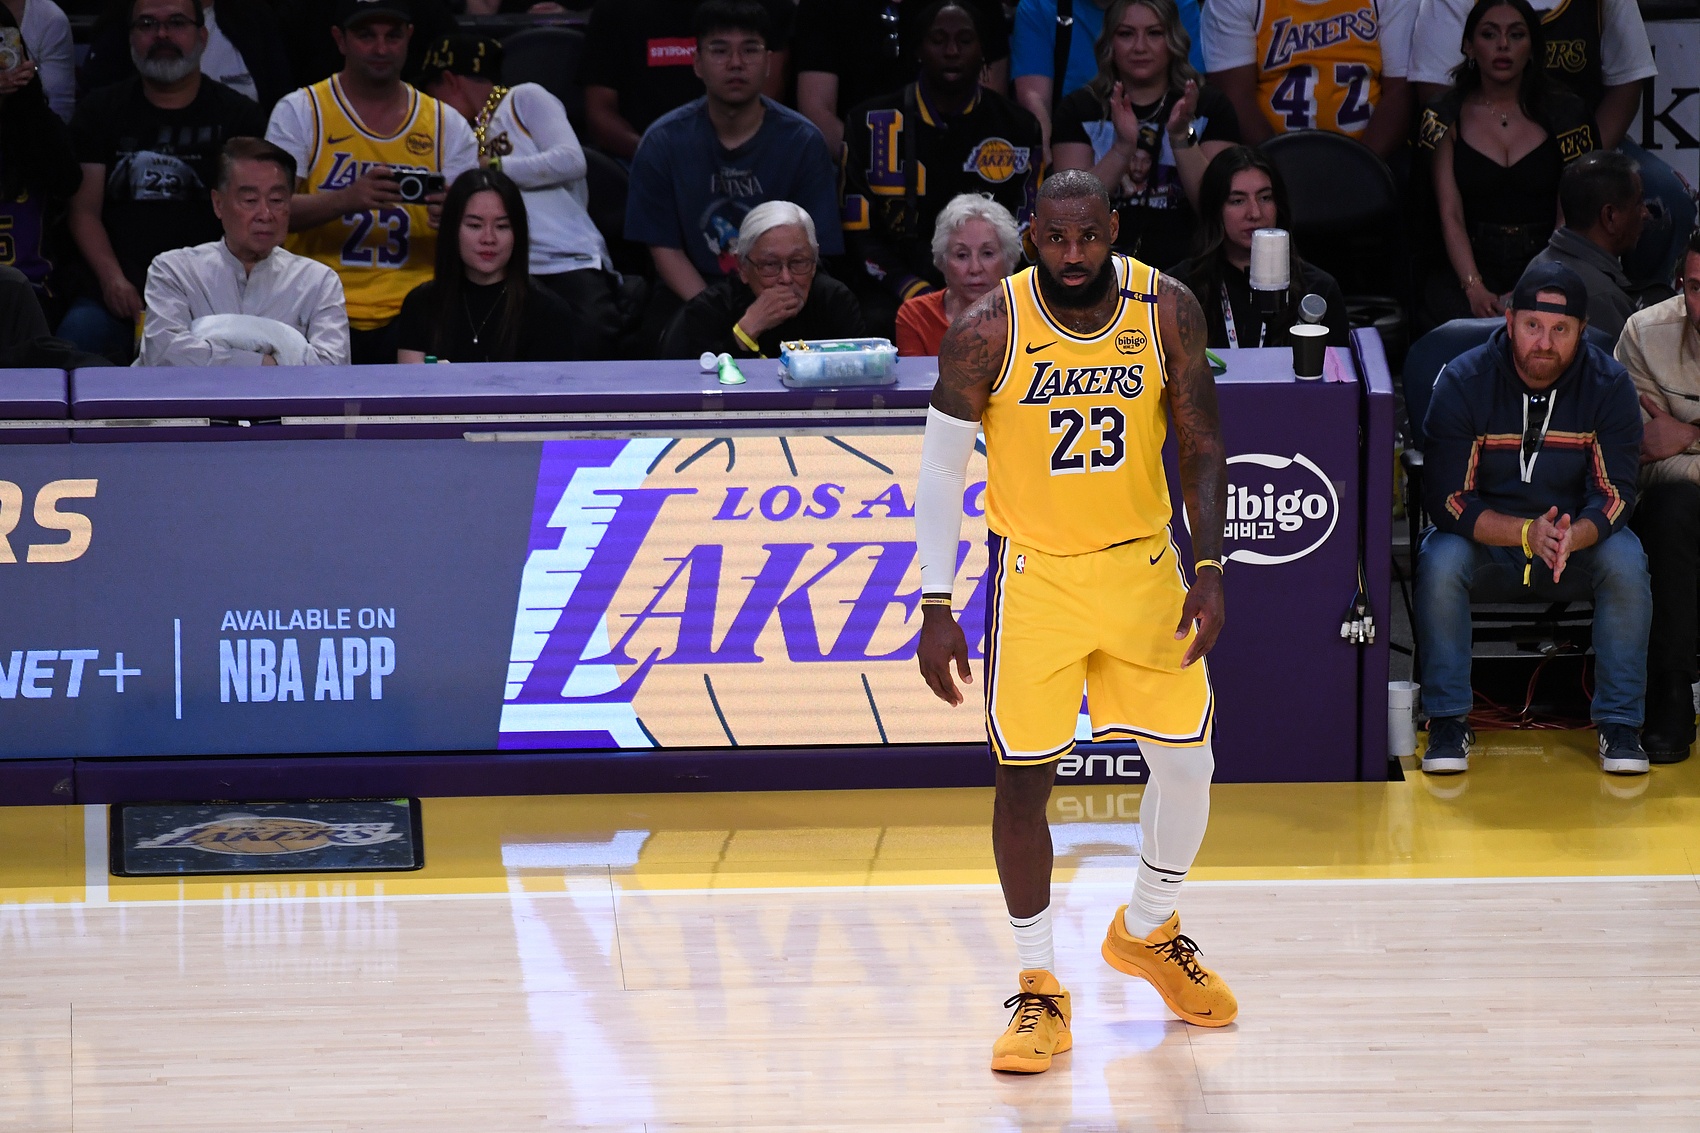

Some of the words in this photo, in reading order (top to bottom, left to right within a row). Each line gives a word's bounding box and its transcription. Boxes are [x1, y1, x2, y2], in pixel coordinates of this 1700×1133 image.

[1262, 7, 1379, 71] LAKERS
[1270, 63, 1376, 132] 42
[145, 169, 182, 197] 23
[341, 203, 411, 268] 23
[1118, 335, 1145, 347] bibigo
[1018, 361, 1145, 405] LAKERS
[1049, 405, 1126, 477] 23
[712, 482, 845, 521] LOS
[1226, 483, 1328, 532] ibigo
[220, 608, 351, 631] AVAILABLE
[358, 607, 396, 629] ON
[219, 638, 305, 703] NBA
[314, 636, 396, 701] APP
[1056, 754, 1141, 777] anc
[156, 827, 383, 847] LAKERS
